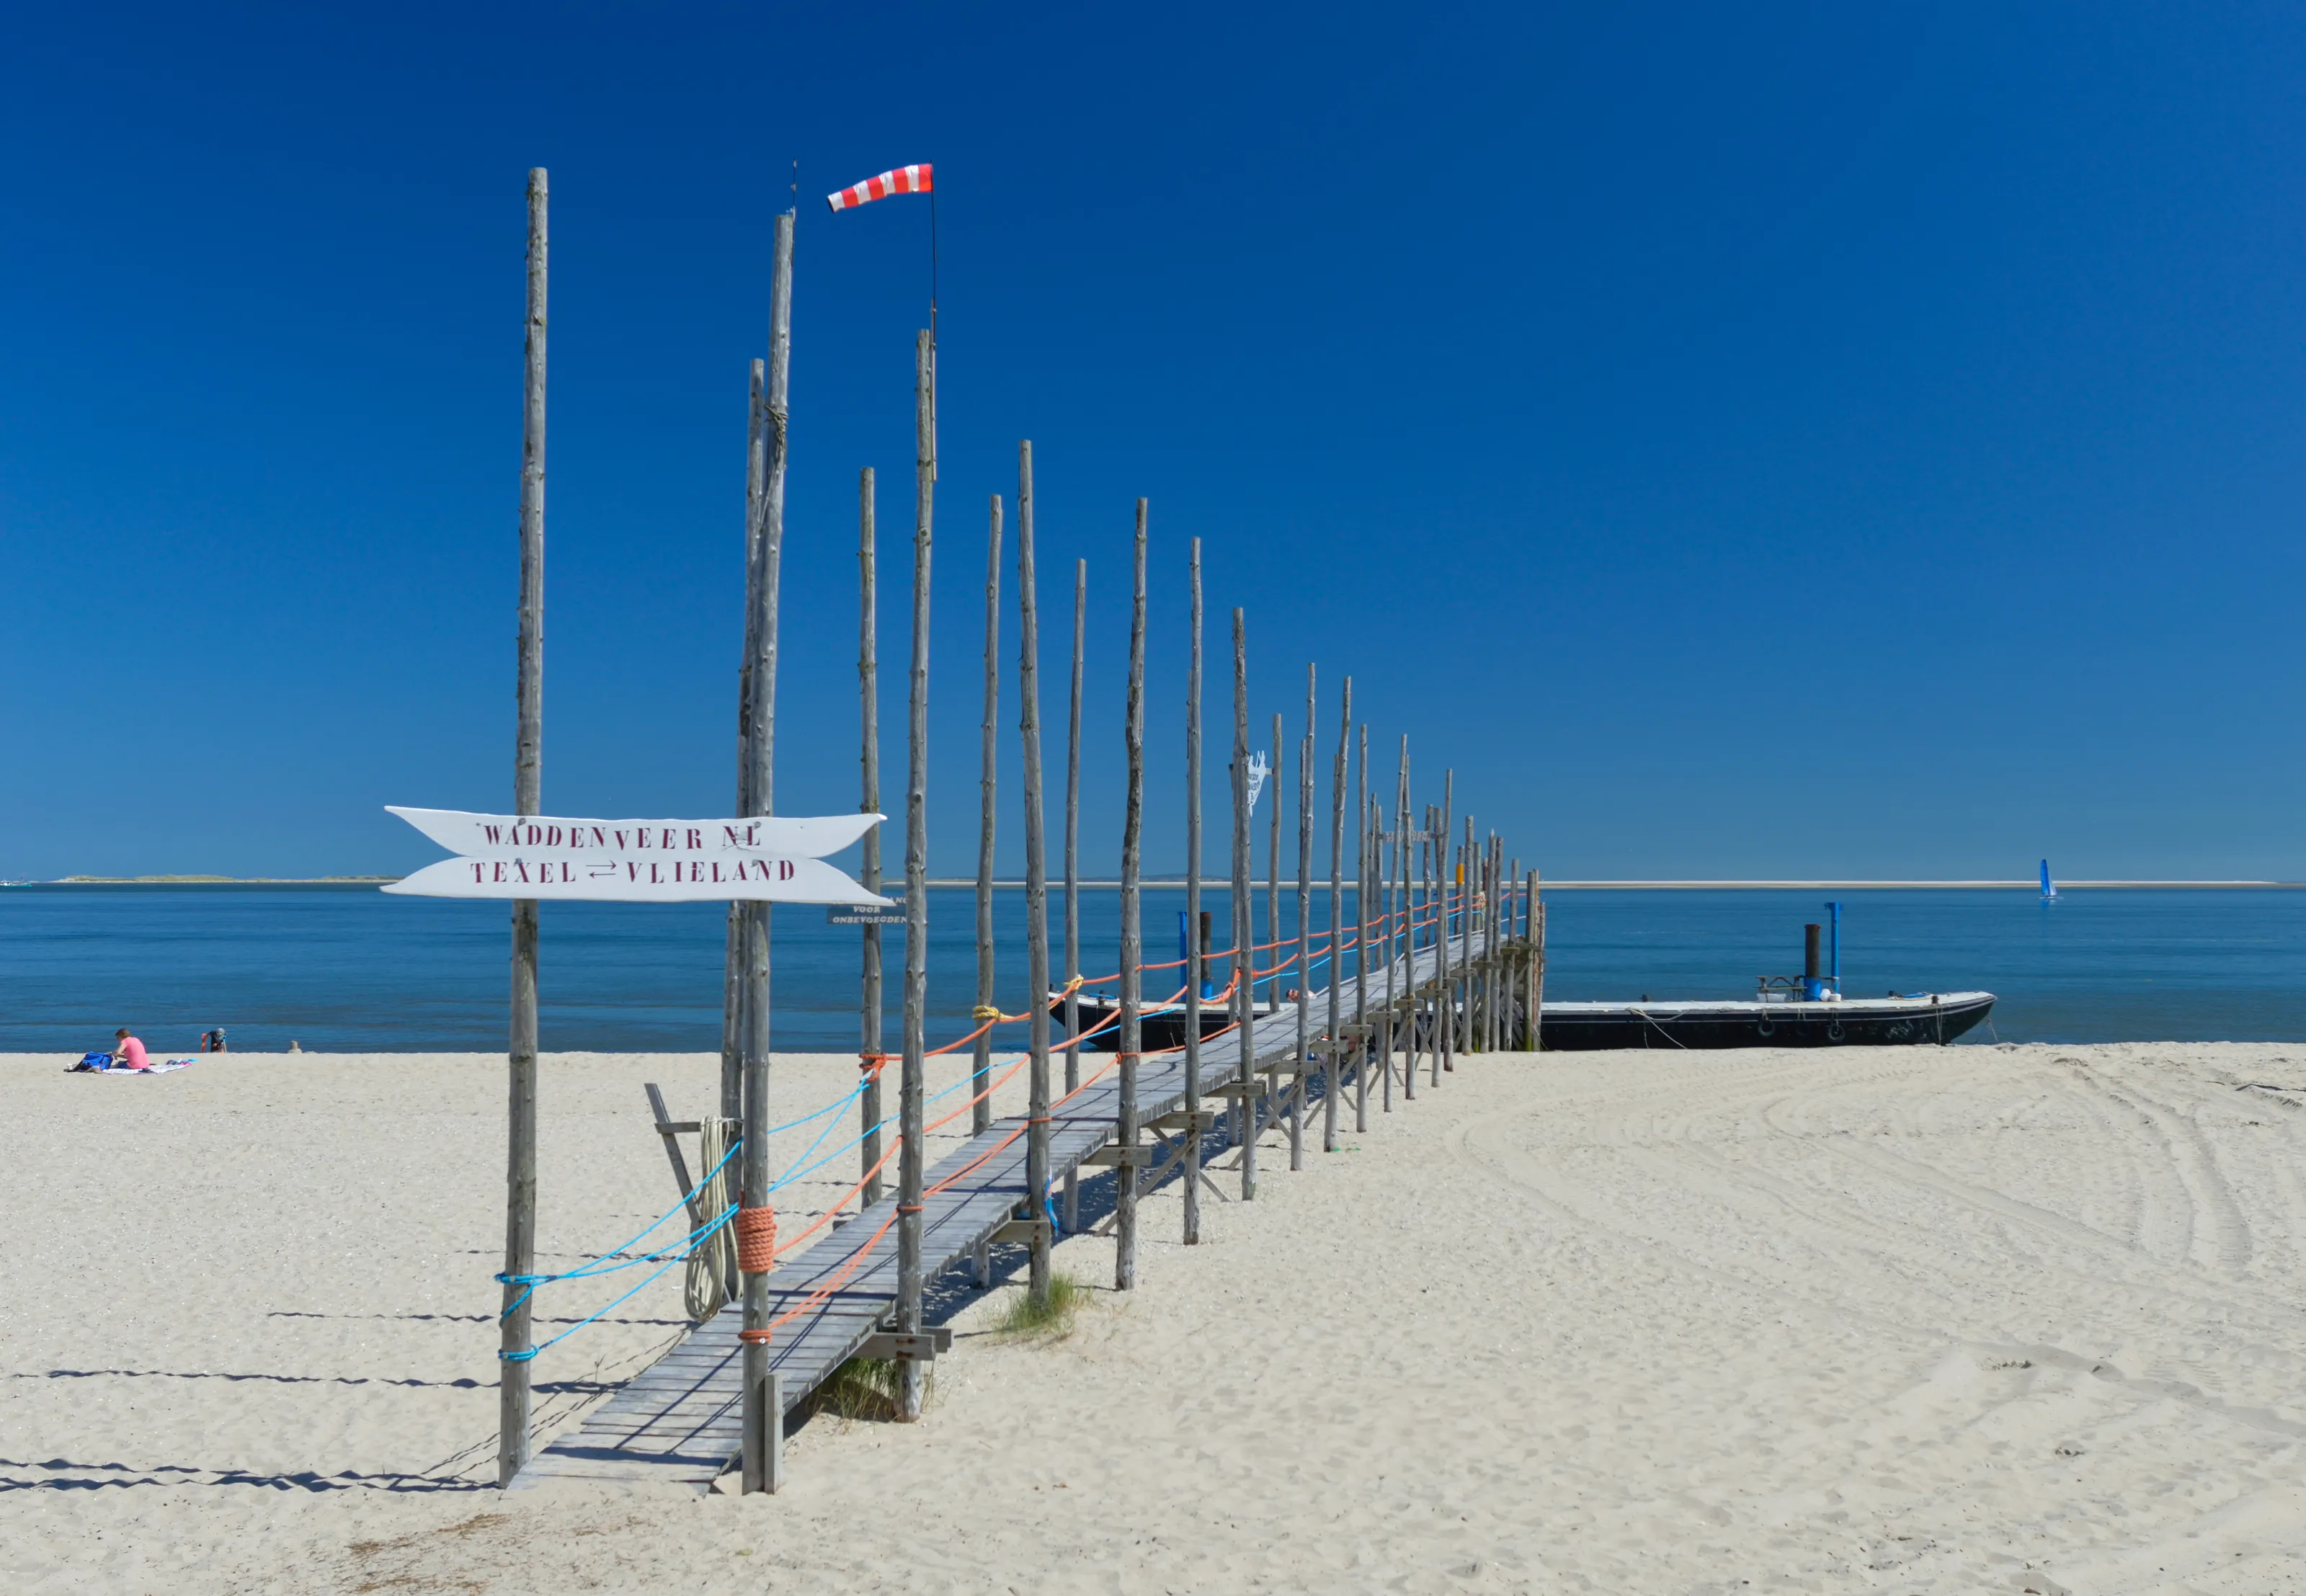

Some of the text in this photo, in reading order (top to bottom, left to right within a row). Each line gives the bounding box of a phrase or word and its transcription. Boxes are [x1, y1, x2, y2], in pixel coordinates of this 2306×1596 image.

[484, 824, 761, 851] WADDENVEER NL
[470, 860, 795, 884] TEXEL VLIELAND
[832, 916, 907, 924] ONBEVOEGDEN
